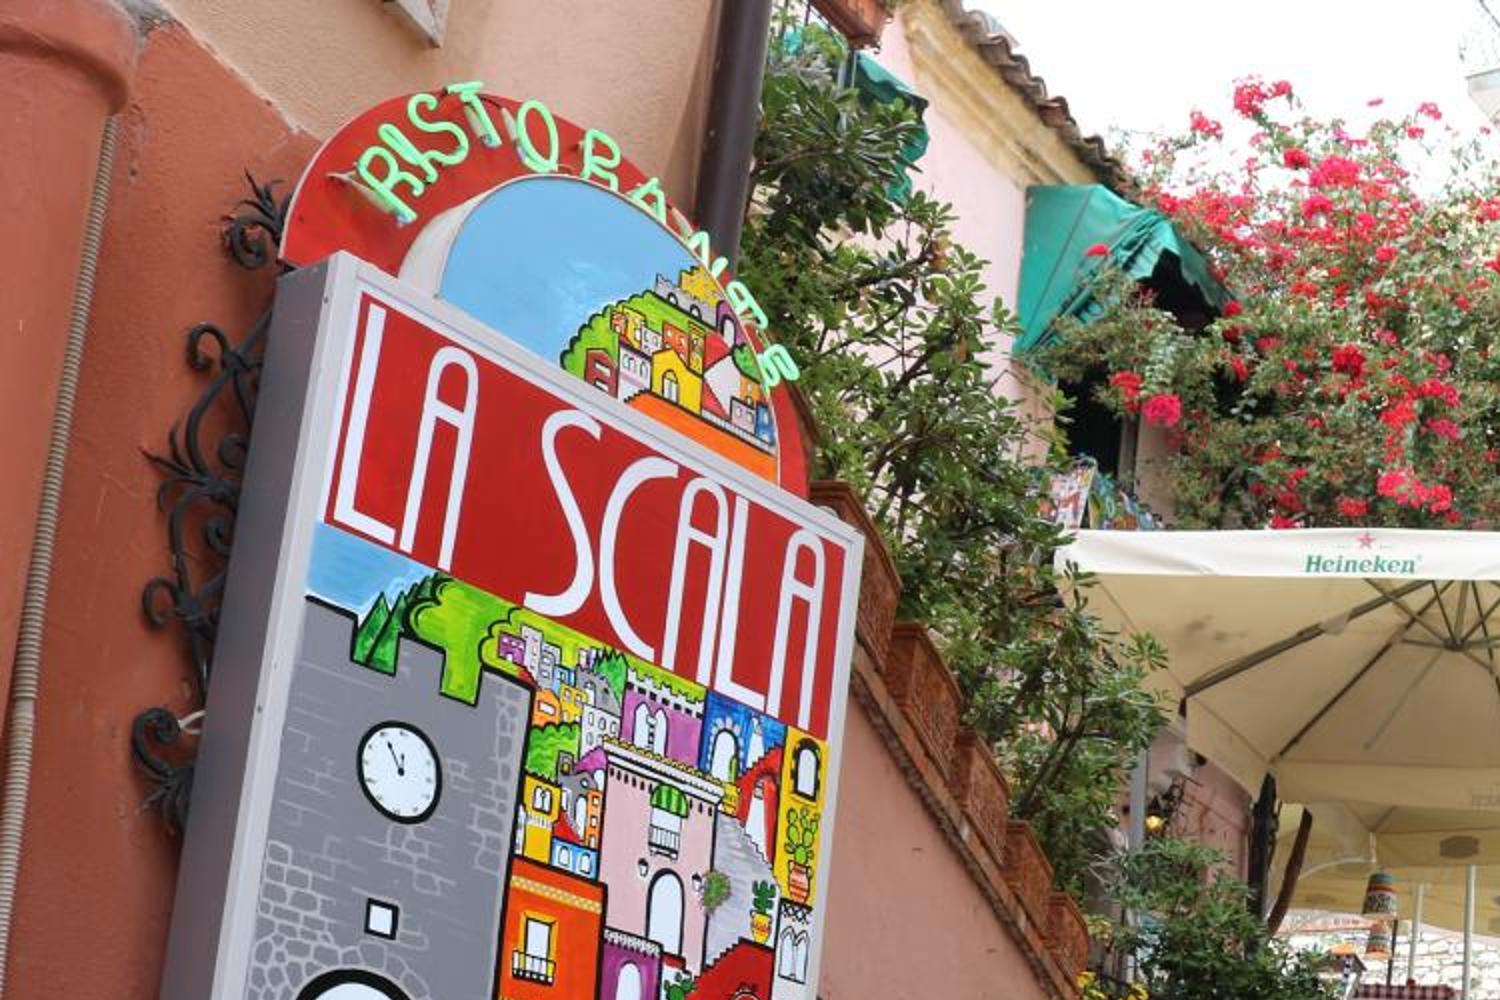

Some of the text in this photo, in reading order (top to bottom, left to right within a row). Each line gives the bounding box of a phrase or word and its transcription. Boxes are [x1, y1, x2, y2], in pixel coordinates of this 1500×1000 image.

[333, 304, 826, 734] LA SCALA
[1305, 554, 1416, 574] Heineken
